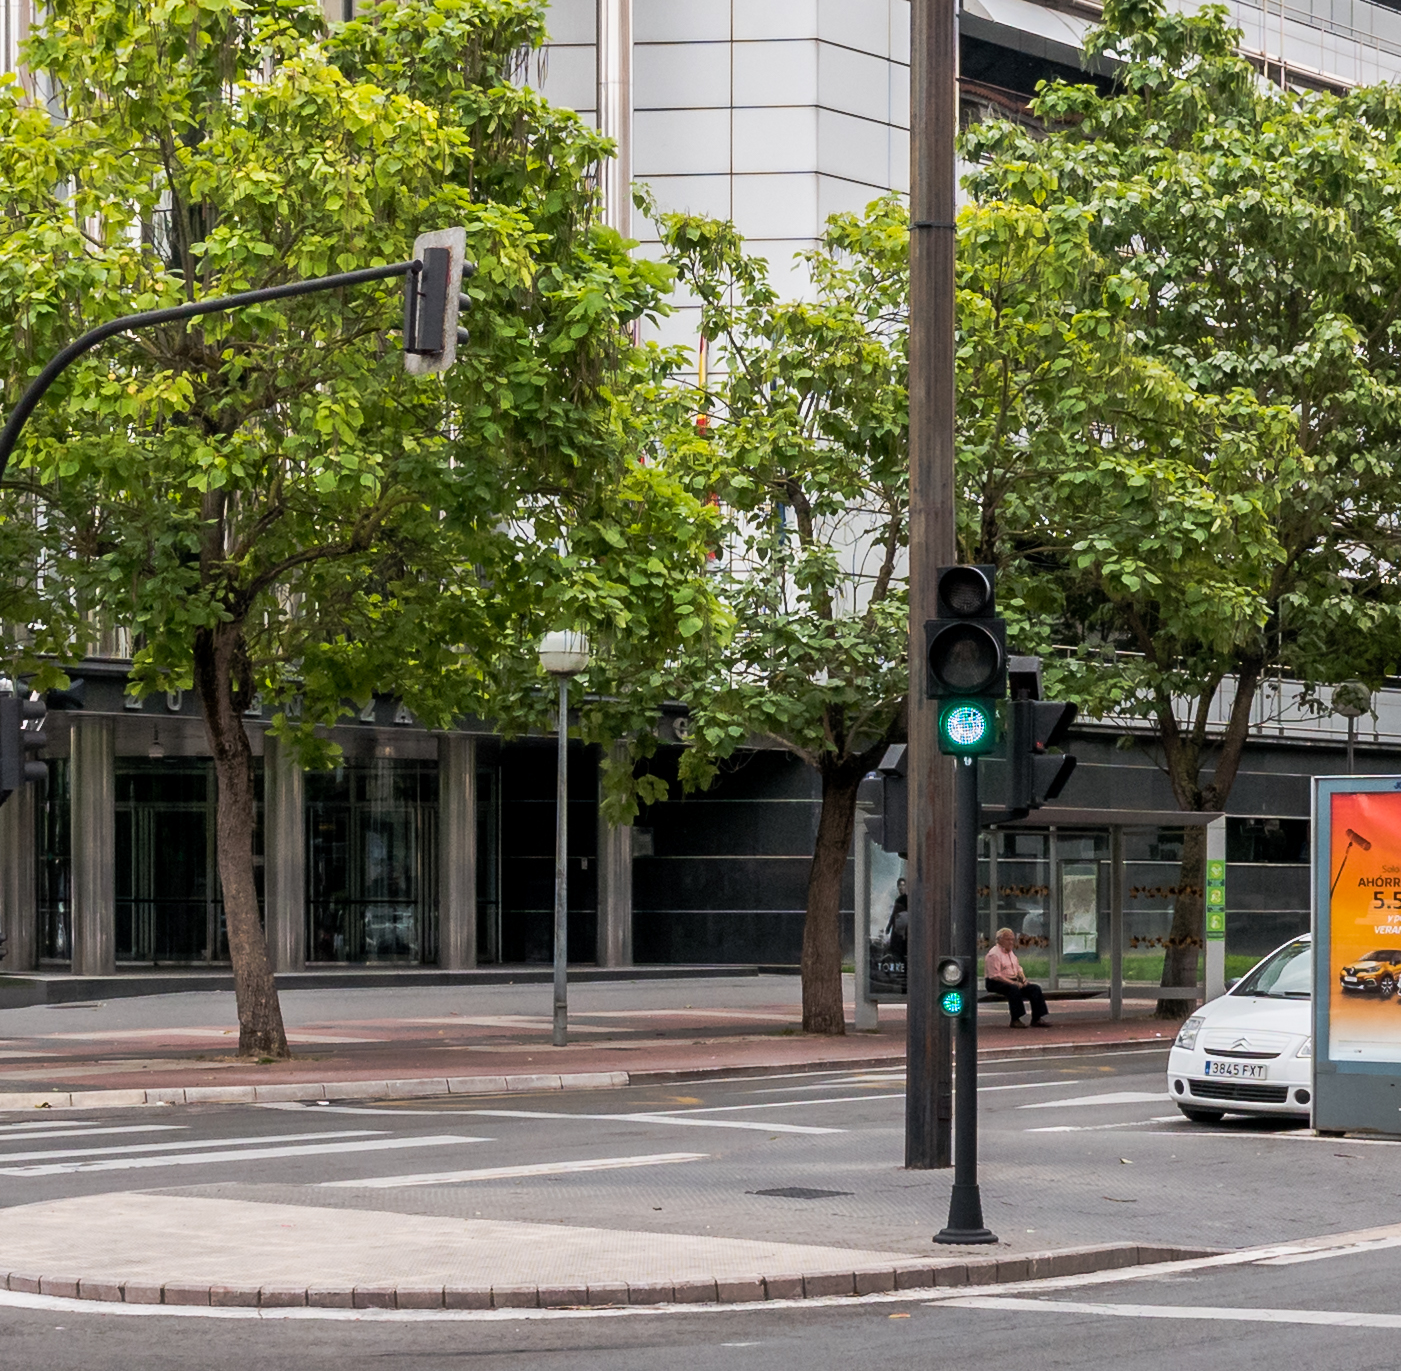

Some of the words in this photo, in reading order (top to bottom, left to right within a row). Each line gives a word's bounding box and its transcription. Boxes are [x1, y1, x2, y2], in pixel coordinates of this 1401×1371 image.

[1381, 864, 1401, 874] Solo
[877, 962, 905, 973] TORRE
[1212, 1062, 1240, 1076] 3845
[1242, 1064, 1264, 1078] FXT
